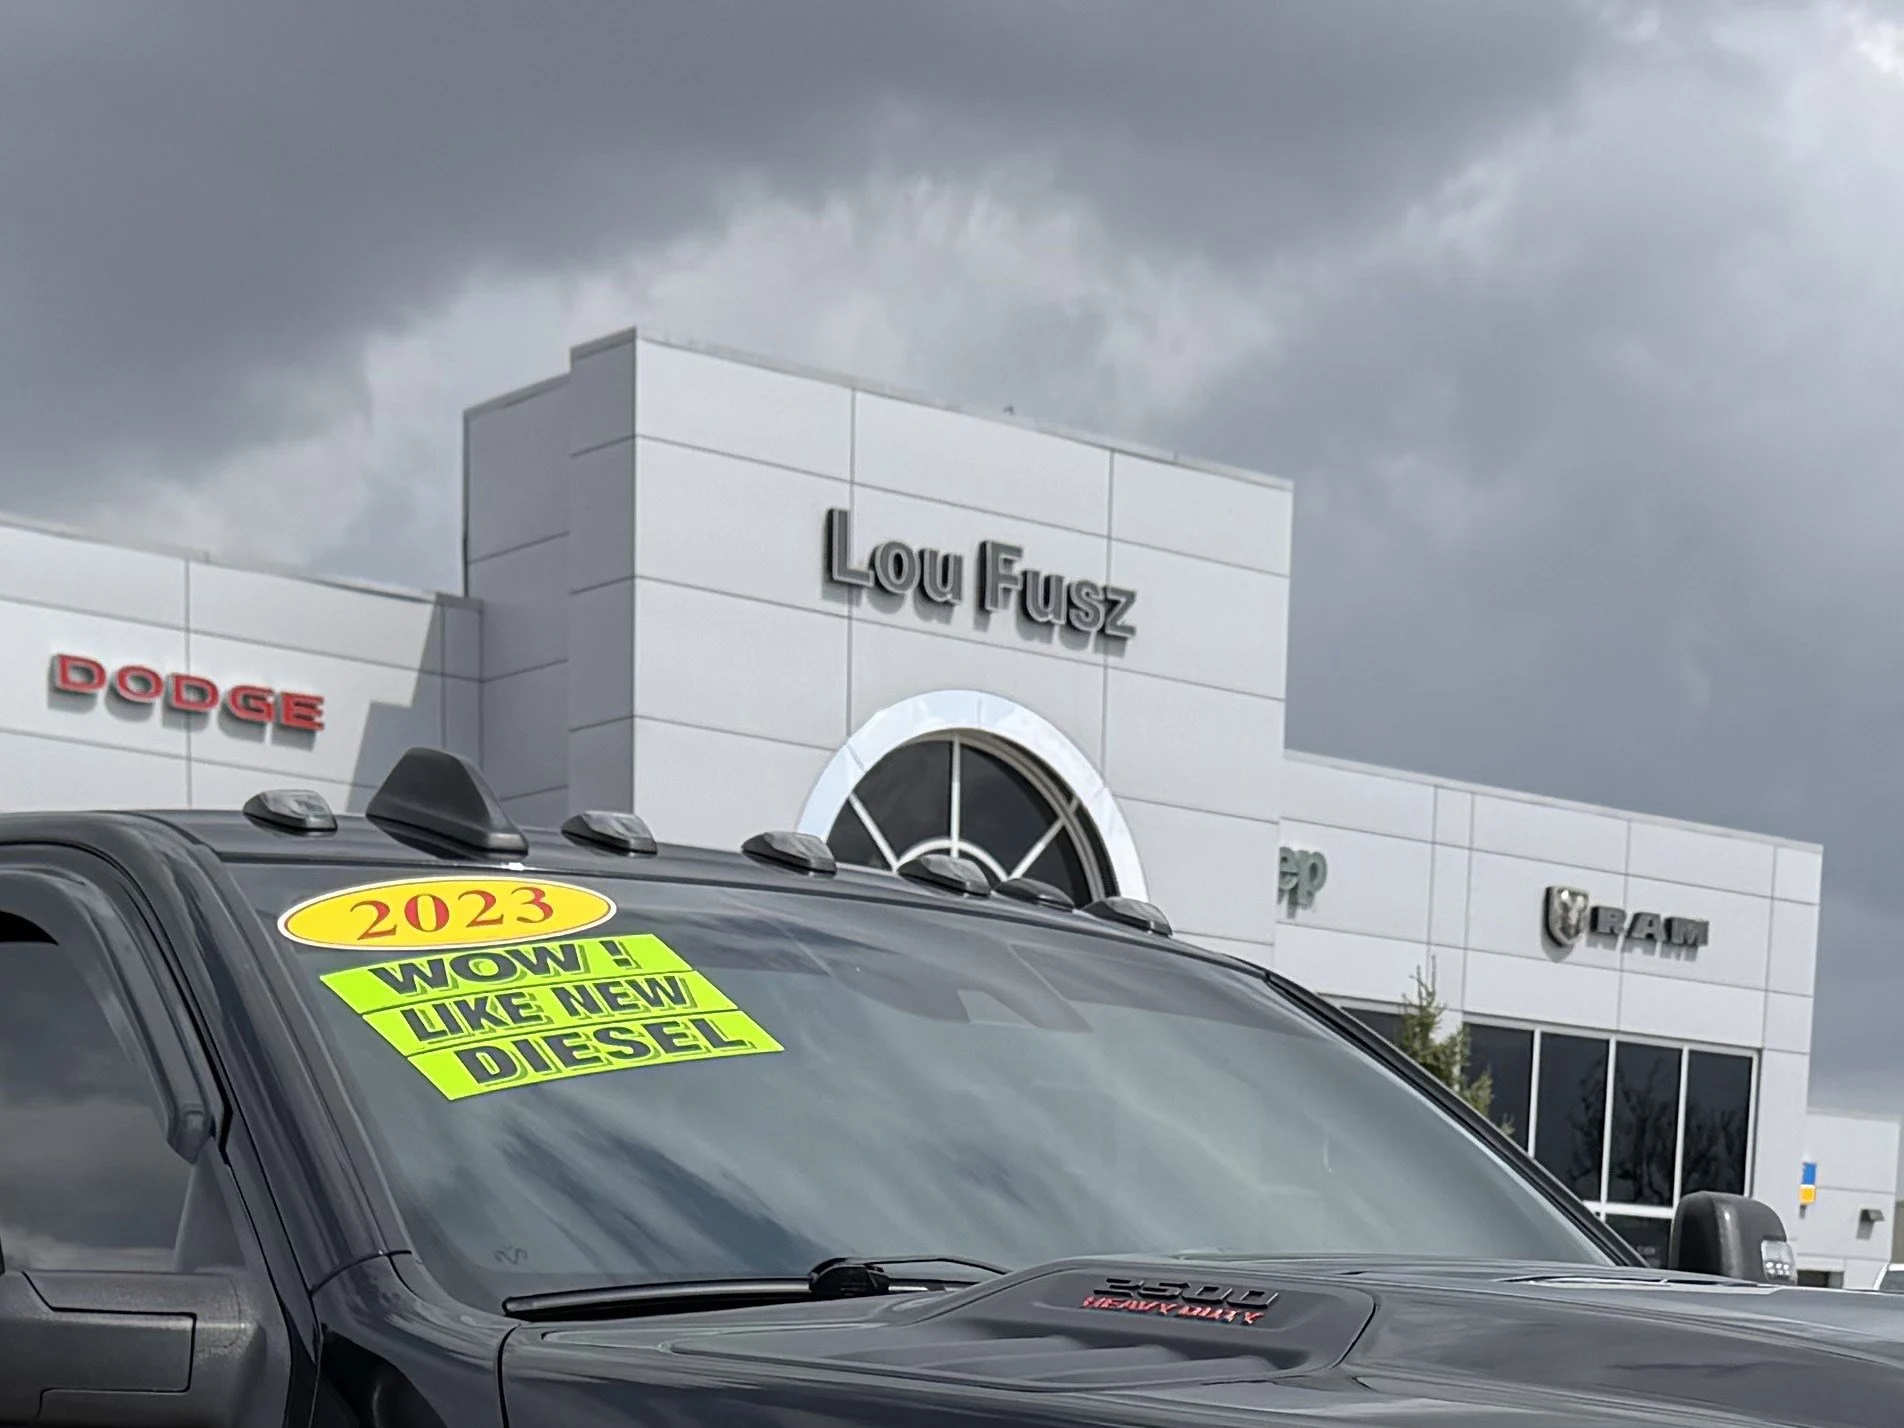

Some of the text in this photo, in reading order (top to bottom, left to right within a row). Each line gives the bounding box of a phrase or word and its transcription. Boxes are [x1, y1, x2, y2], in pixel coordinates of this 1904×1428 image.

[825, 507, 1138, 640] Lou Fusz
[50, 653, 326, 732] DODGE
[348, 886, 556, 941] 2023
[1590, 905, 1710, 947] RAM
[368, 942, 587, 996] WOW
[400, 974, 693, 1044] LIKE NEW
[451, 1017, 752, 1086] DIESEL
[1081, 1295, 1178, 1315] HEAVY
